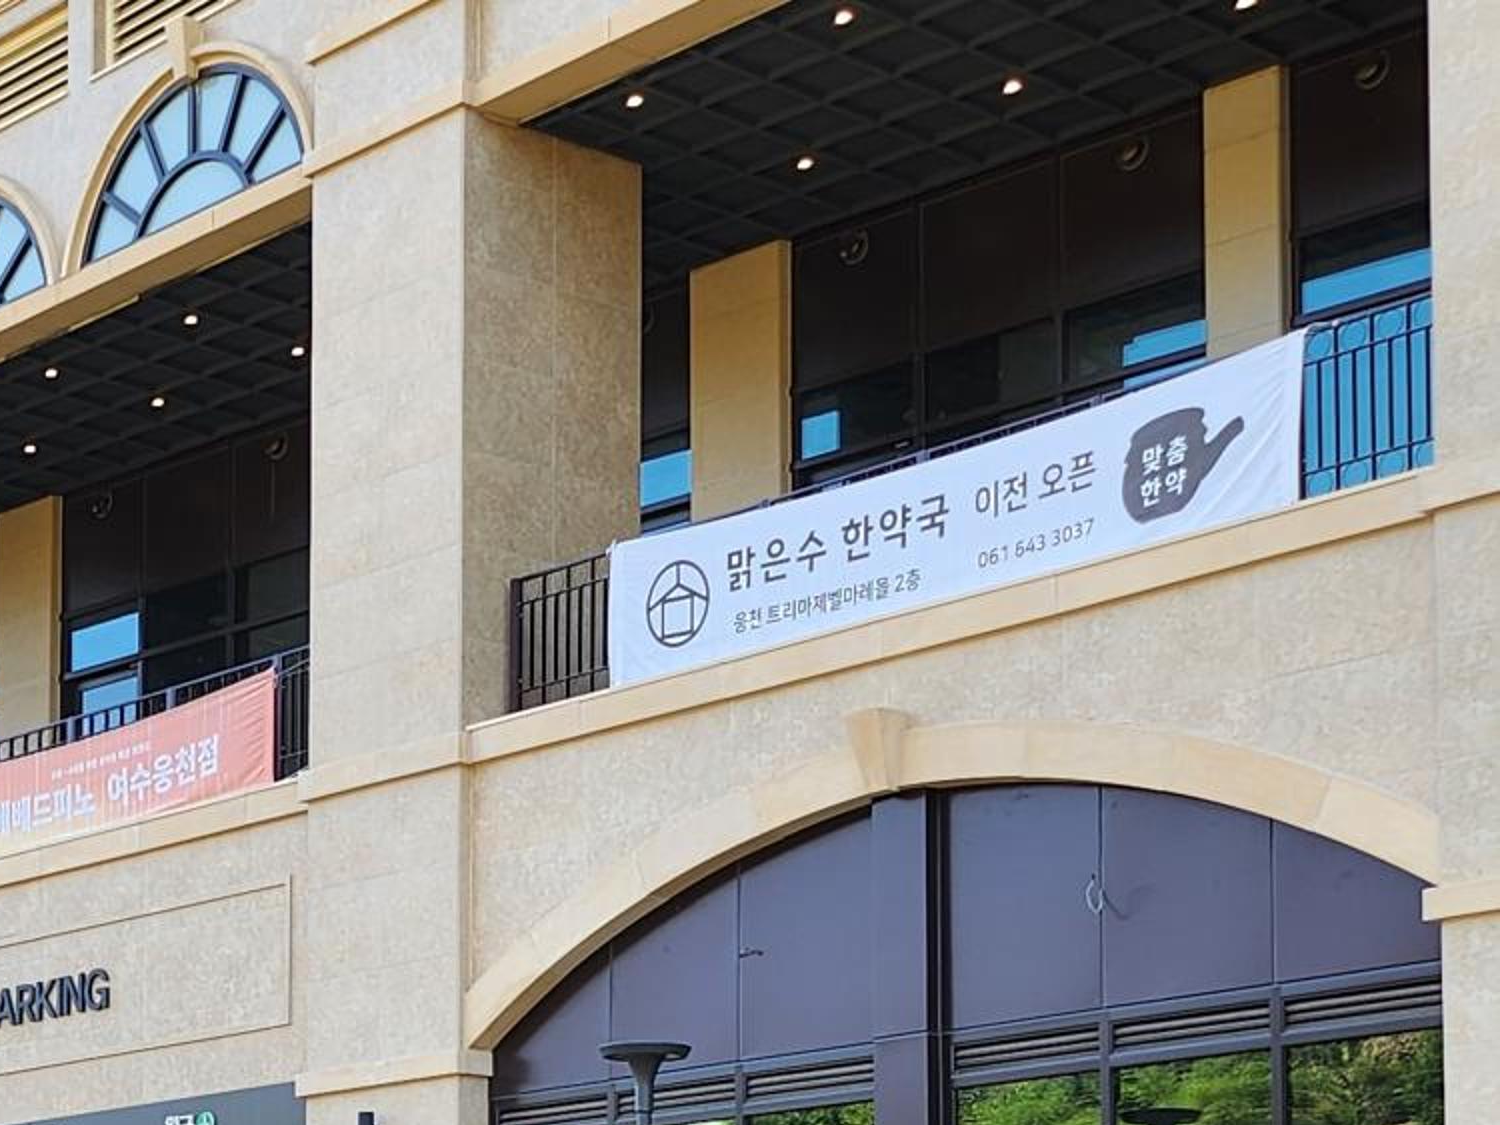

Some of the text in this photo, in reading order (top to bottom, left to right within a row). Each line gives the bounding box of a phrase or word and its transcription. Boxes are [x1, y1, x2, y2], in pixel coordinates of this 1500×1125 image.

[1141, 435, 1188, 475] 맞춤
[1140, 467, 1187, 508] 한약
[727, 451, 1097, 592] 맑은수 한약국 이전 오픈
[977, 517, 1095, 568] 061 643 3037
[733, 608, 762, 634] 웅천
[894, 568, 921, 593] 2층
[108, 734, 220, 801] 여수웅천점
